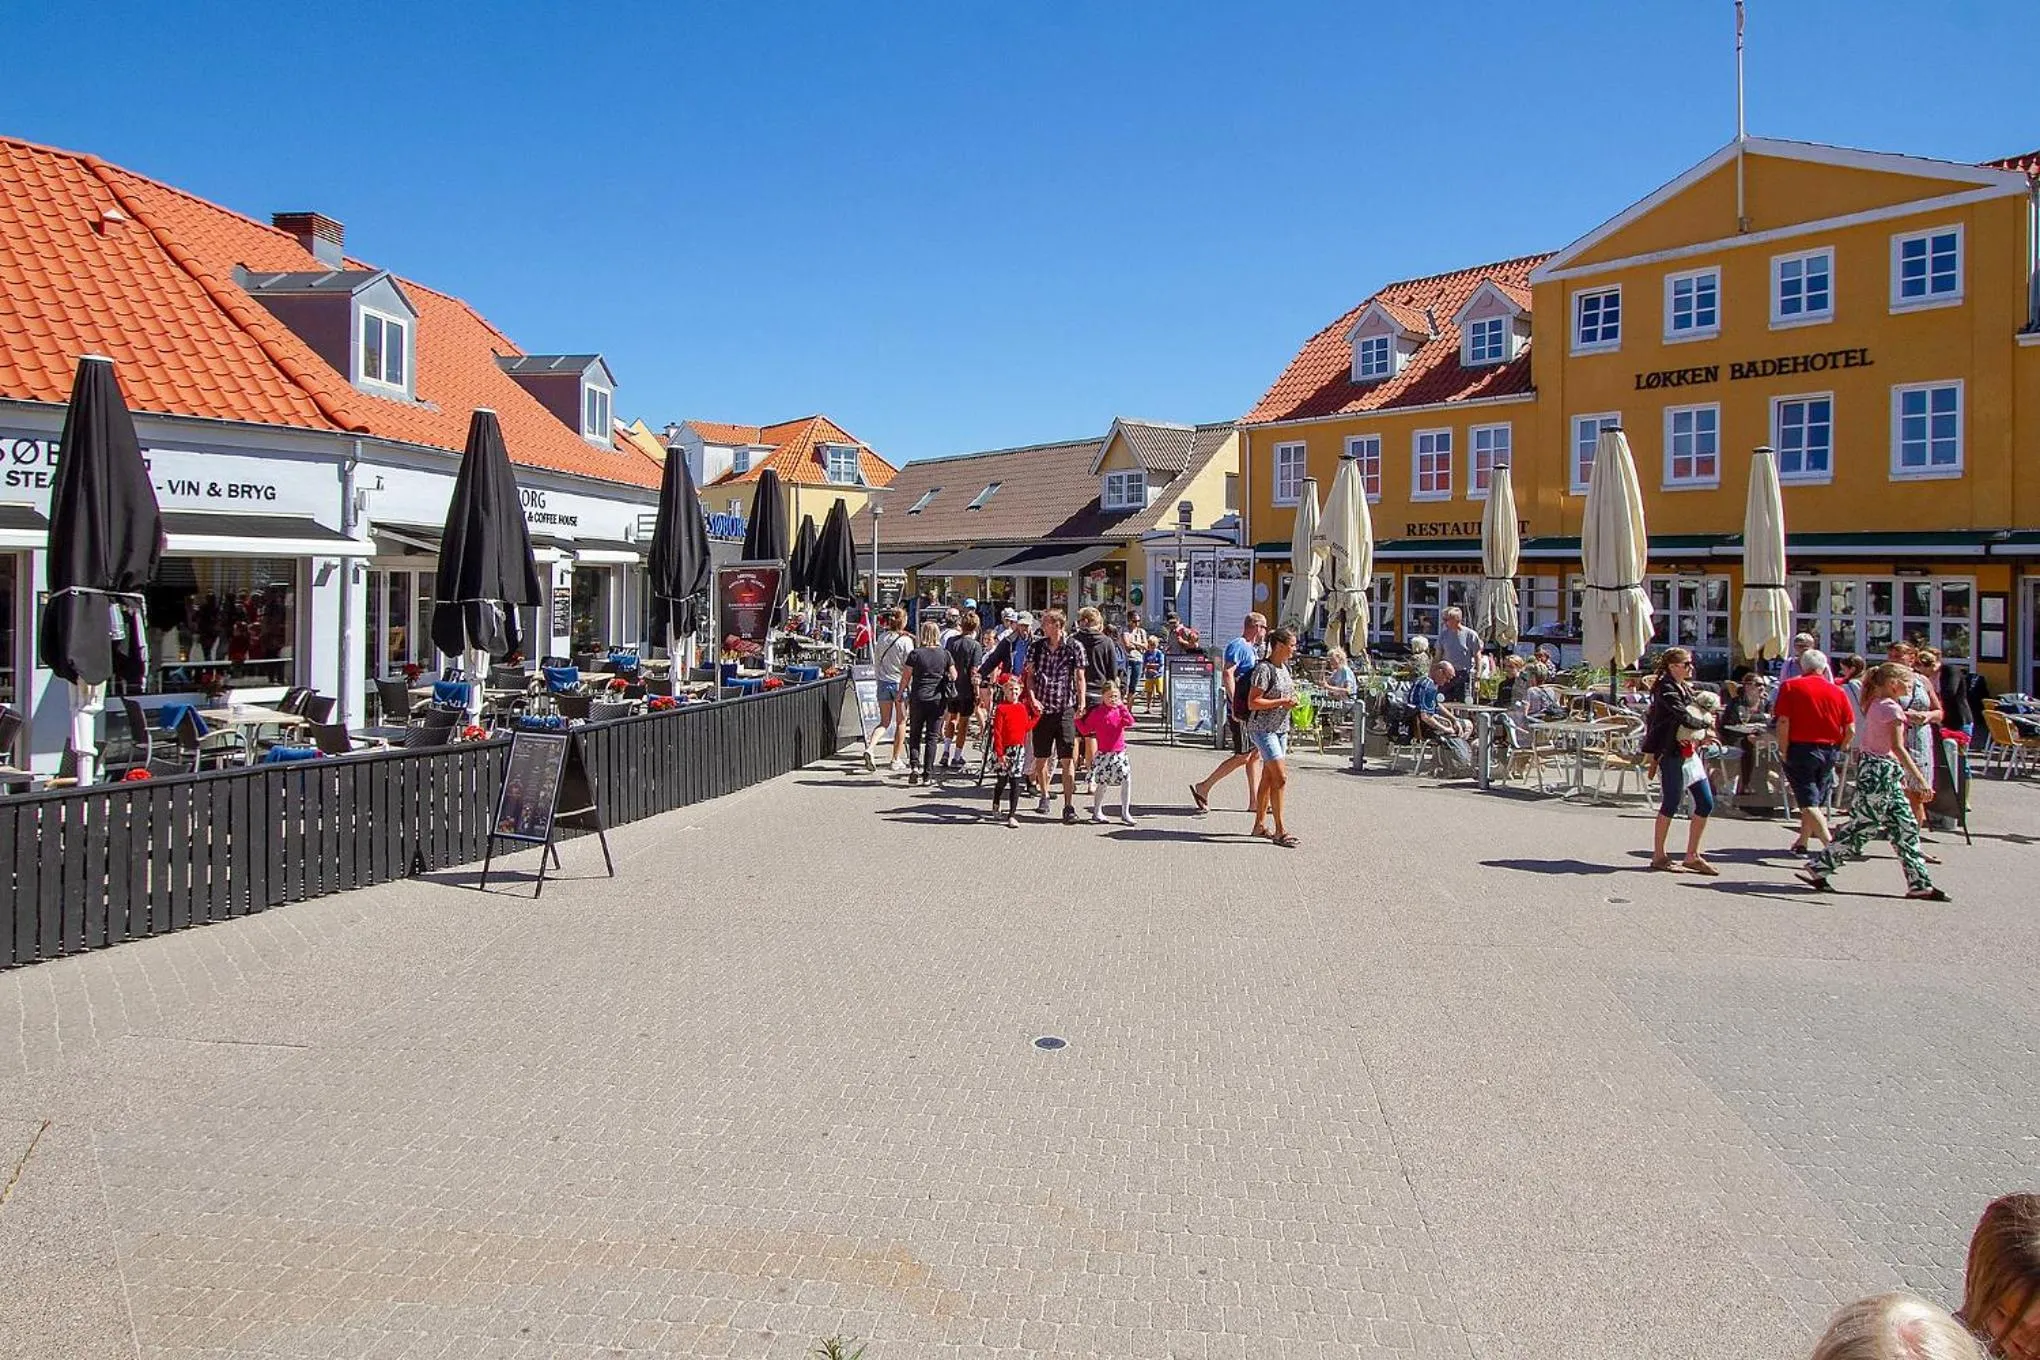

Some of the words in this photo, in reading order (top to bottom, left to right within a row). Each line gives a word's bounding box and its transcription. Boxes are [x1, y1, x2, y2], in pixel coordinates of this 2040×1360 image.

[1635, 366, 1719, 390] LØKKEN
[1729, 348, 1875, 380] BADEHOTEL
[167, 480, 200, 496] VIN
[207, 482, 222, 497] &
[228, 483, 277, 500] BRYG
[517, 489, 546, 509] ORG
[534, 512, 557, 524] COFFEE
[559, 514, 578, 527] HOUSE
[1406, 521, 1530, 536] RESTAUT
